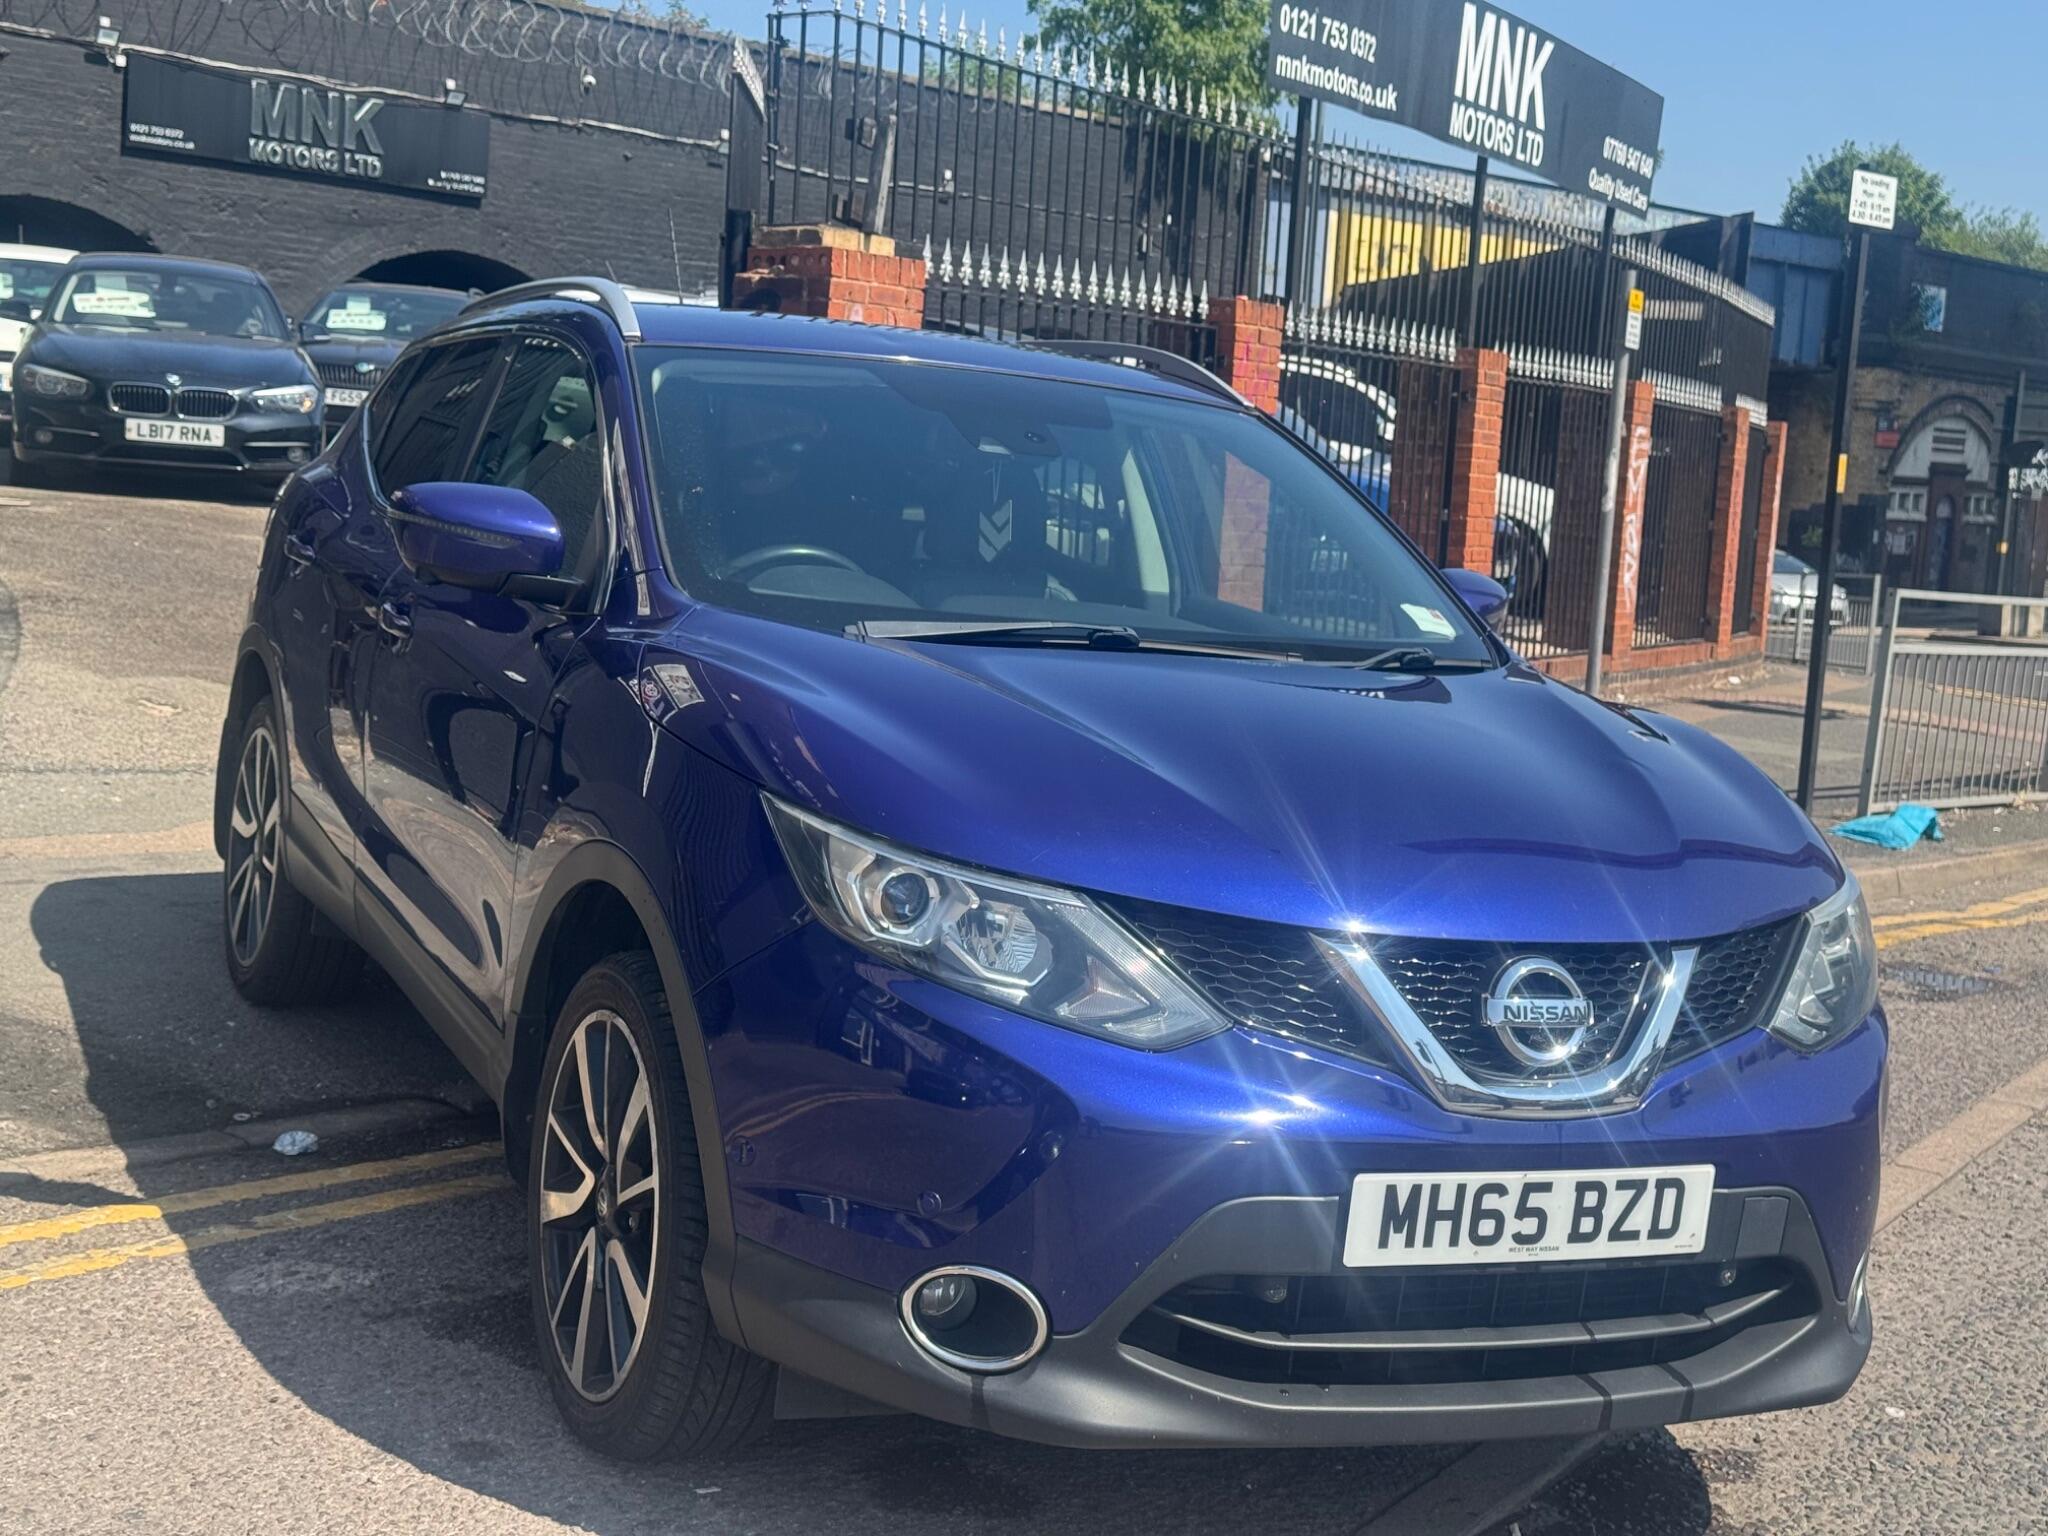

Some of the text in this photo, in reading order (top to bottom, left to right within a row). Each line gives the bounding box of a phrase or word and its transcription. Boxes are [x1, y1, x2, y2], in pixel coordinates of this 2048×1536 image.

[1280, 3, 1377, 64] 0121 753 0372
[1275, 54, 1398, 111] mnkmotors.co.uk
[1454, 2, 1554, 131] MNK
[251, 78, 384, 155] MNK
[1449, 101, 1544, 167] MOTORS LTD
[249, 138, 382, 178] MOTORS LTD
[1588, 167, 1648, 212] Quality Used Cars
[136, 423, 212, 442] LB17 RNA
[1503, 1003, 1588, 1022] NISSAN
[1378, 1177, 1686, 1249] MH65 BZD
